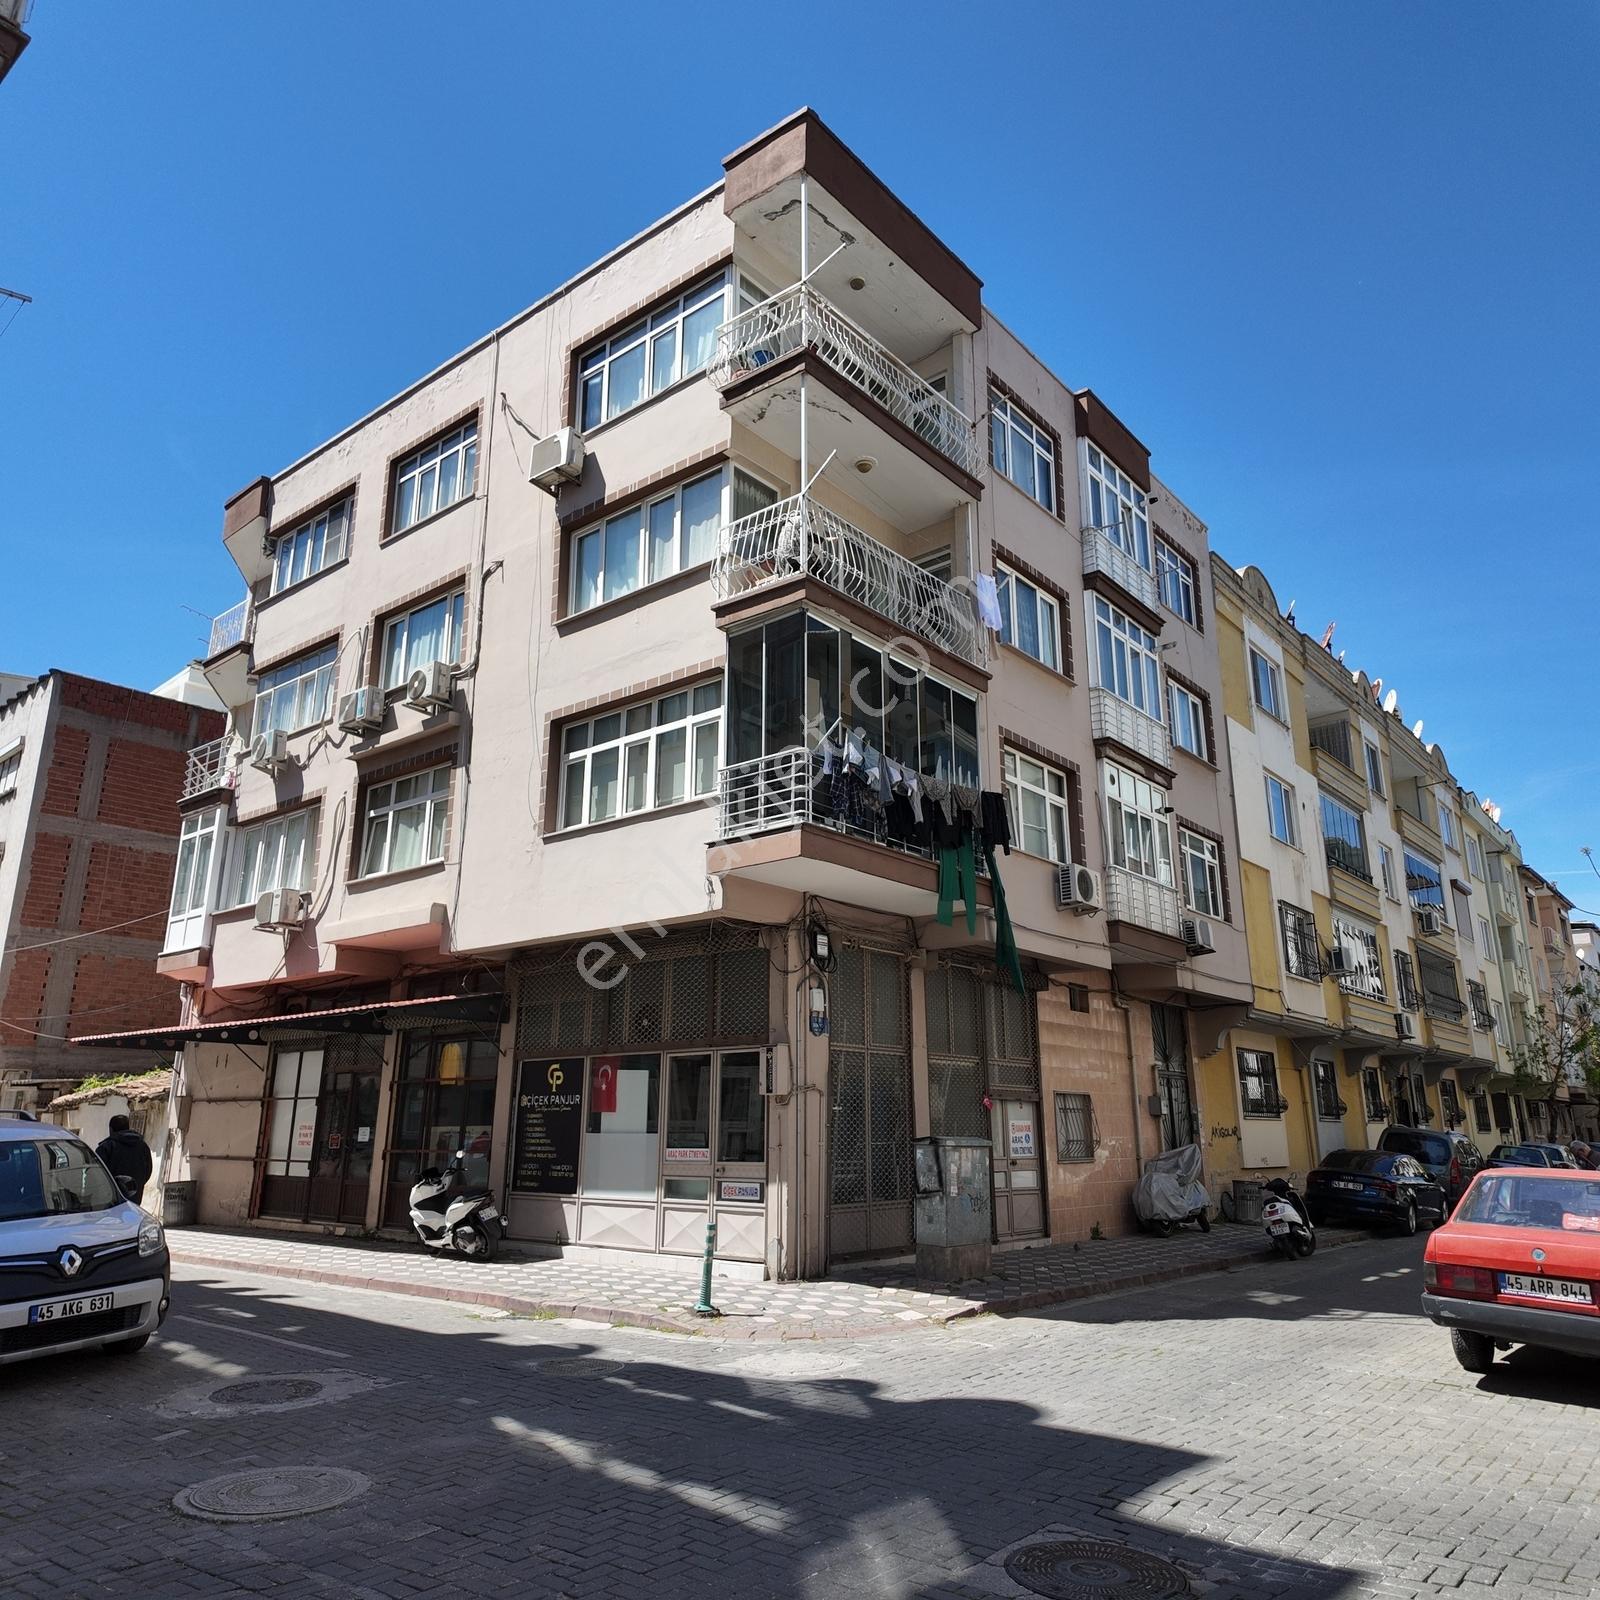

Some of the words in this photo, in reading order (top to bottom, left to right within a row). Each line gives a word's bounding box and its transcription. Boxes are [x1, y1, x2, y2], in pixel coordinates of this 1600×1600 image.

[550, 1094, 581, 1105] PANJUR
[1507, 1275, 1523, 1290] 45
[1530, 1279, 1554, 1295] ARR
[1560, 1283, 1587, 1299] 844
[38, 1305, 54, 1320] 45
[61, 1301, 83, 1316] AKG
[90, 1296, 110, 1311] 631
